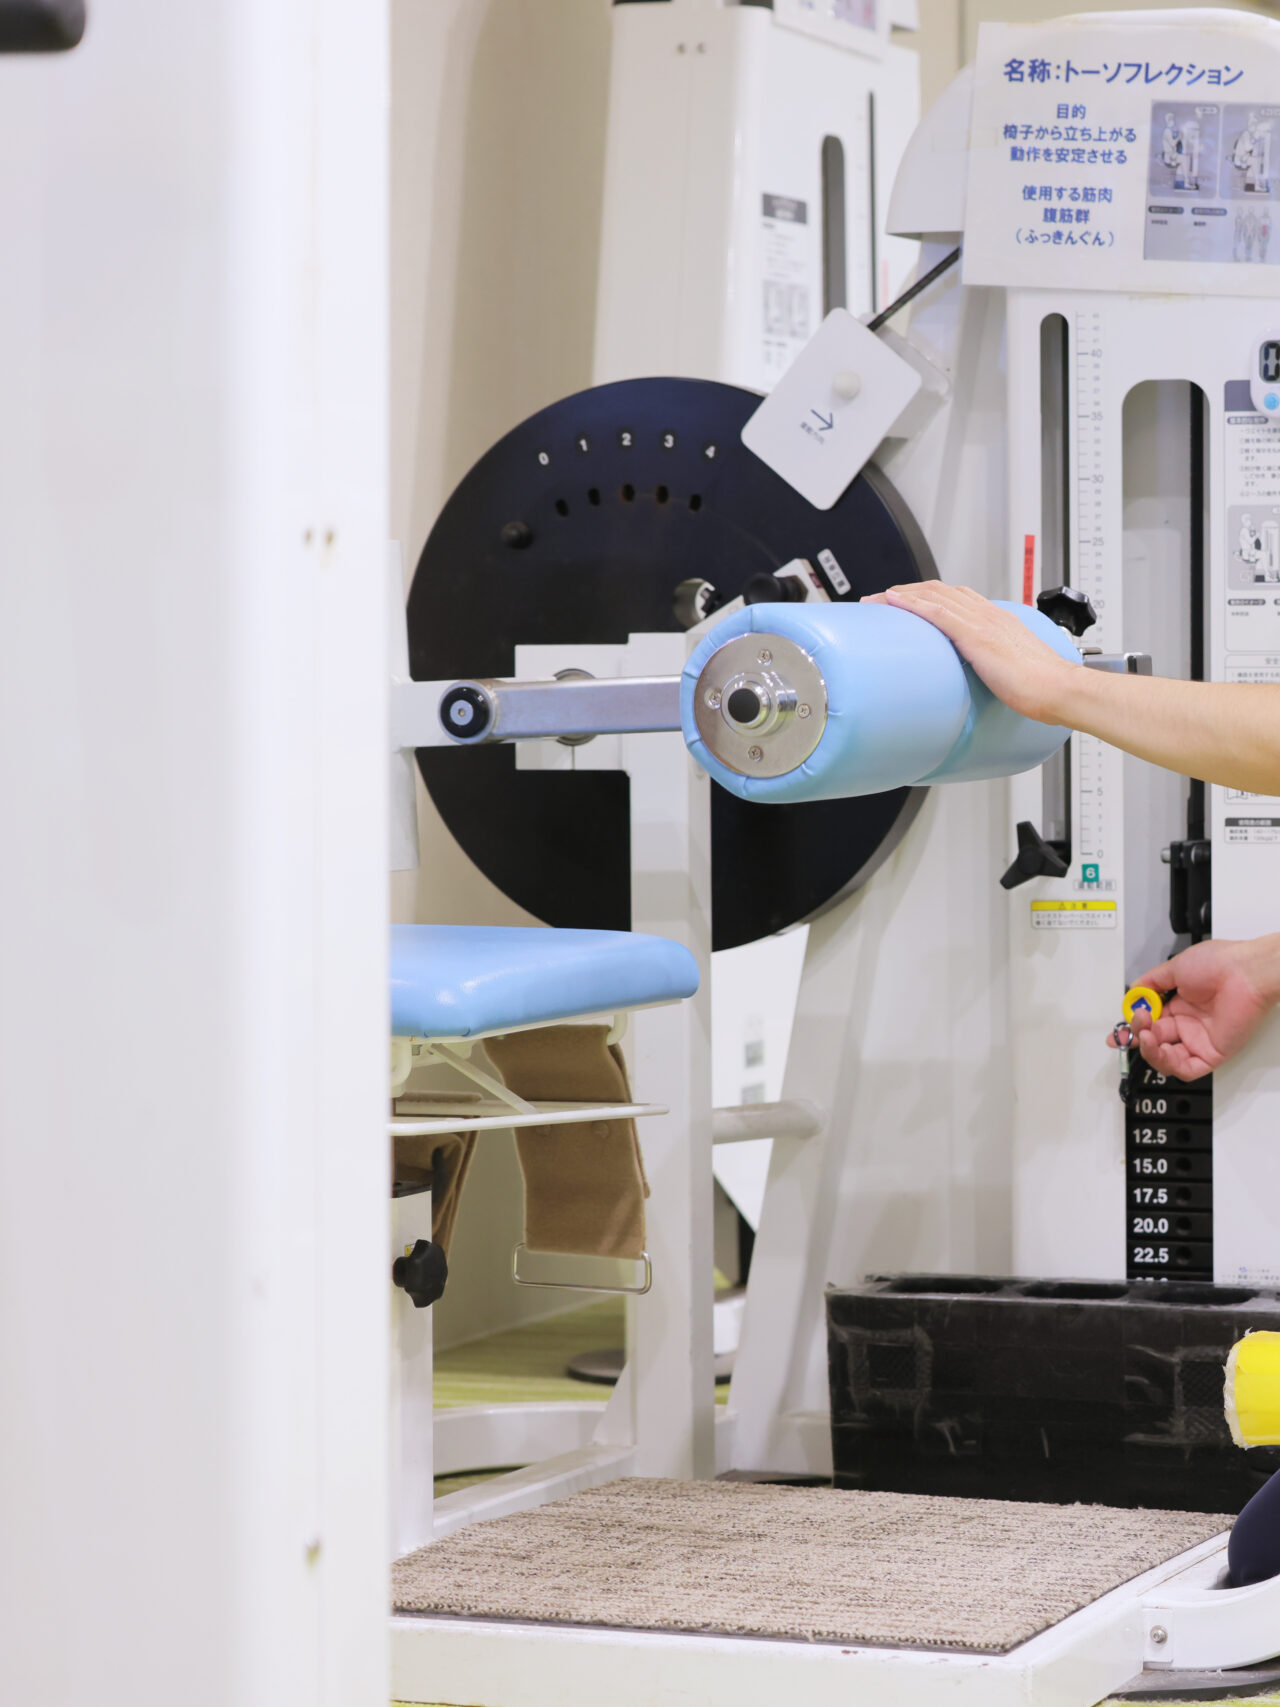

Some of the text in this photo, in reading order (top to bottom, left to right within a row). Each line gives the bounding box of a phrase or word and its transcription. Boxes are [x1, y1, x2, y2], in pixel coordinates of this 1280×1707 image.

[1057, 103, 1087, 119] 目的
[1003, 124, 1137, 143] 椅子から立ち上がる
[1010, 146, 1128, 164] 動作を安定させる
[1022, 185, 1113, 203] 使用する筋肉
[1042, 207, 1091, 224] 腹筋群
[579, 438, 588, 452] 1
[621, 432, 632, 446] 2
[663, 434, 674, 448] 3
[538, 452, 550, 466] 0
[705, 445, 716, 459] 4
[1085, 866, 1097, 879] 6
[1135, 1099, 1167, 1115] 10.0
[1133, 1128, 1168, 1145] 12.5
[1133, 1158, 1168, 1174] 15.0
[1133, 1187, 1169, 1204] 17.5
[1133, 1217, 1169, 1234] 20.0
[1133, 1247, 1169, 1264] 22.5
